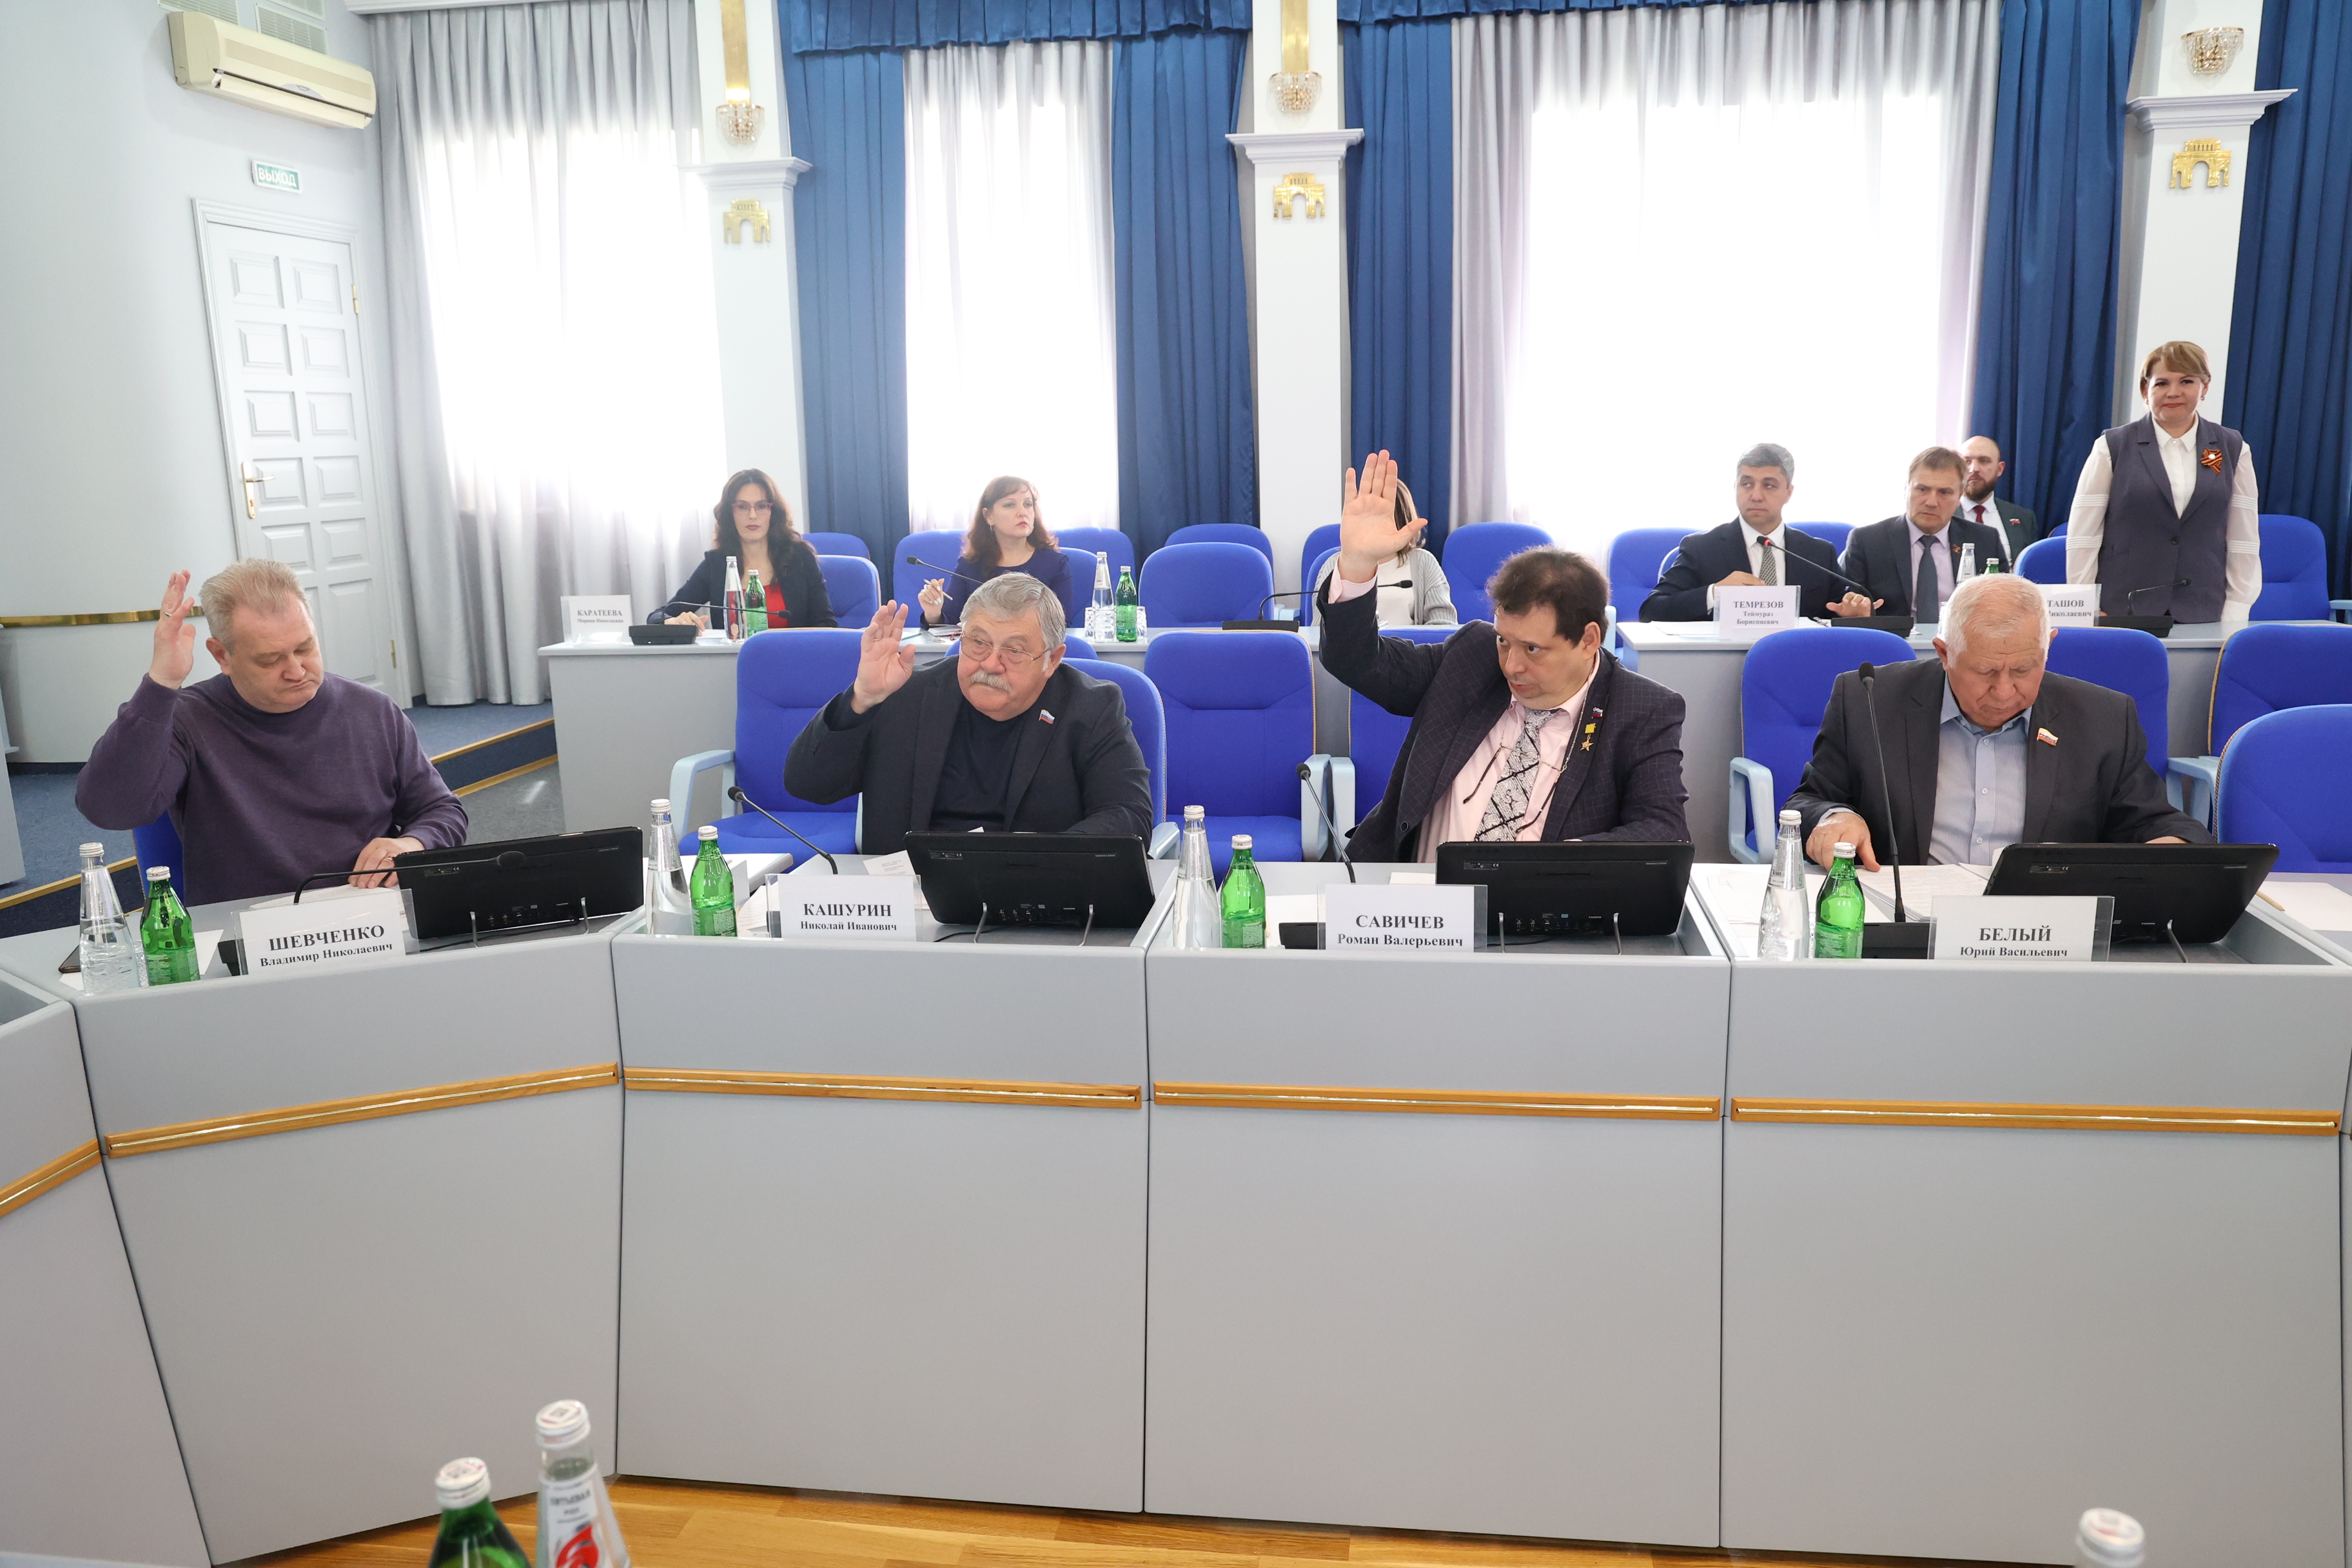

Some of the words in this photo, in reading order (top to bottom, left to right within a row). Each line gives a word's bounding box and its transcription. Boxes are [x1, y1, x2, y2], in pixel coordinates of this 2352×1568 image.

[258, 167, 297, 188] ВЫХОД
[803, 903, 892, 917] КАШУРИН
[800, 921, 844, 930] Николай
[847, 921, 897, 930] Иванович
[1356, 915, 1444, 929] САВИЧЕВ
[269, 925, 385, 951] ШЕВЧЕНКО
[1978, 925, 2052, 941] БЕЛЫЙ
[1337, 934, 1378, 945] Роман
[1383, 934, 1463, 948] Валерьевич
[260, 953, 319, 967] Владимир
[322, 943, 393, 959] Николаевич
[1960, 946, 1995, 958] Юрий
[1999, 947, 2068, 957] Васильевич
